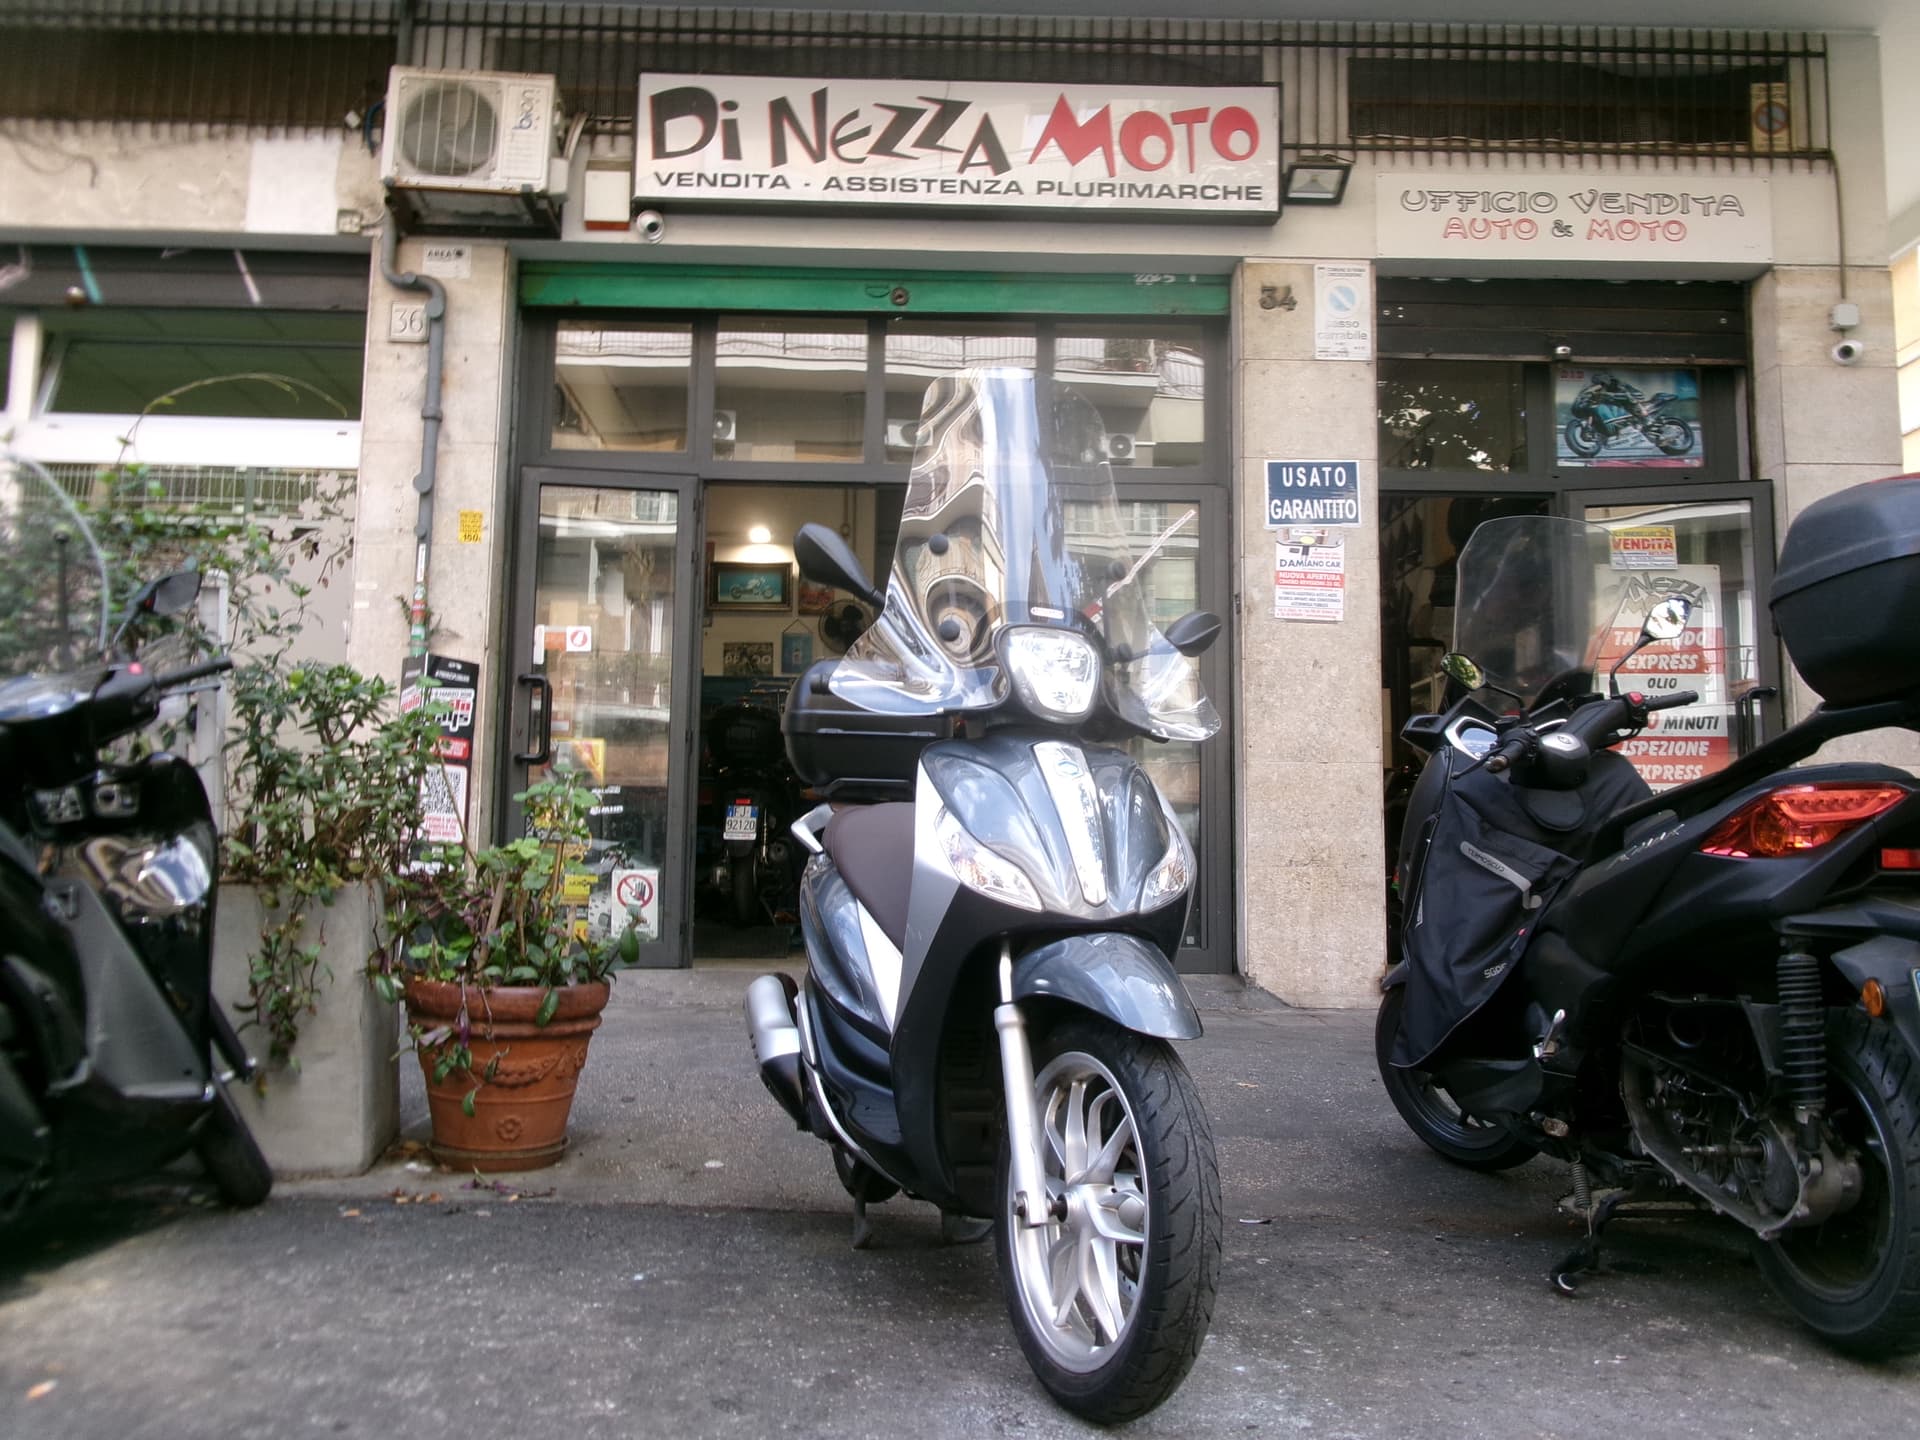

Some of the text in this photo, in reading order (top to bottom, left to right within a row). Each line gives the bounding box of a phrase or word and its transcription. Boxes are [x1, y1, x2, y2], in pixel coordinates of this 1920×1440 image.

[649, 86, 743, 161] Di
[1028, 92, 1260, 178] MOTO
[653, 171, 791, 190] VENDITA
[823, 176, 1025, 196] ASSISTENZA
[1036, 180, 1263, 201] PLURIMARCHE
[1400, 188, 1745, 217] UFFICIO VENDITA
[1443, 217, 1687, 242] AUTO & MOTO
[1259, 285, 1298, 311] 34
[394, 308, 424, 334] 36
[1282, 466, 1346, 488] USATO
[1270, 498, 1357, 519] GARANTITO
[1611, 537, 1675, 551] VENDITA
[1279, 558, 1324, 568] DAMIANO
[1626, 653, 1699, 671] EXPRESS
[1647, 676, 1678, 690] OLIO
[1663, 715, 1720, 731] MINUTI
[1621, 740, 1710, 757] ISPEZIONE
[727, 819, 756, 831] 92120
